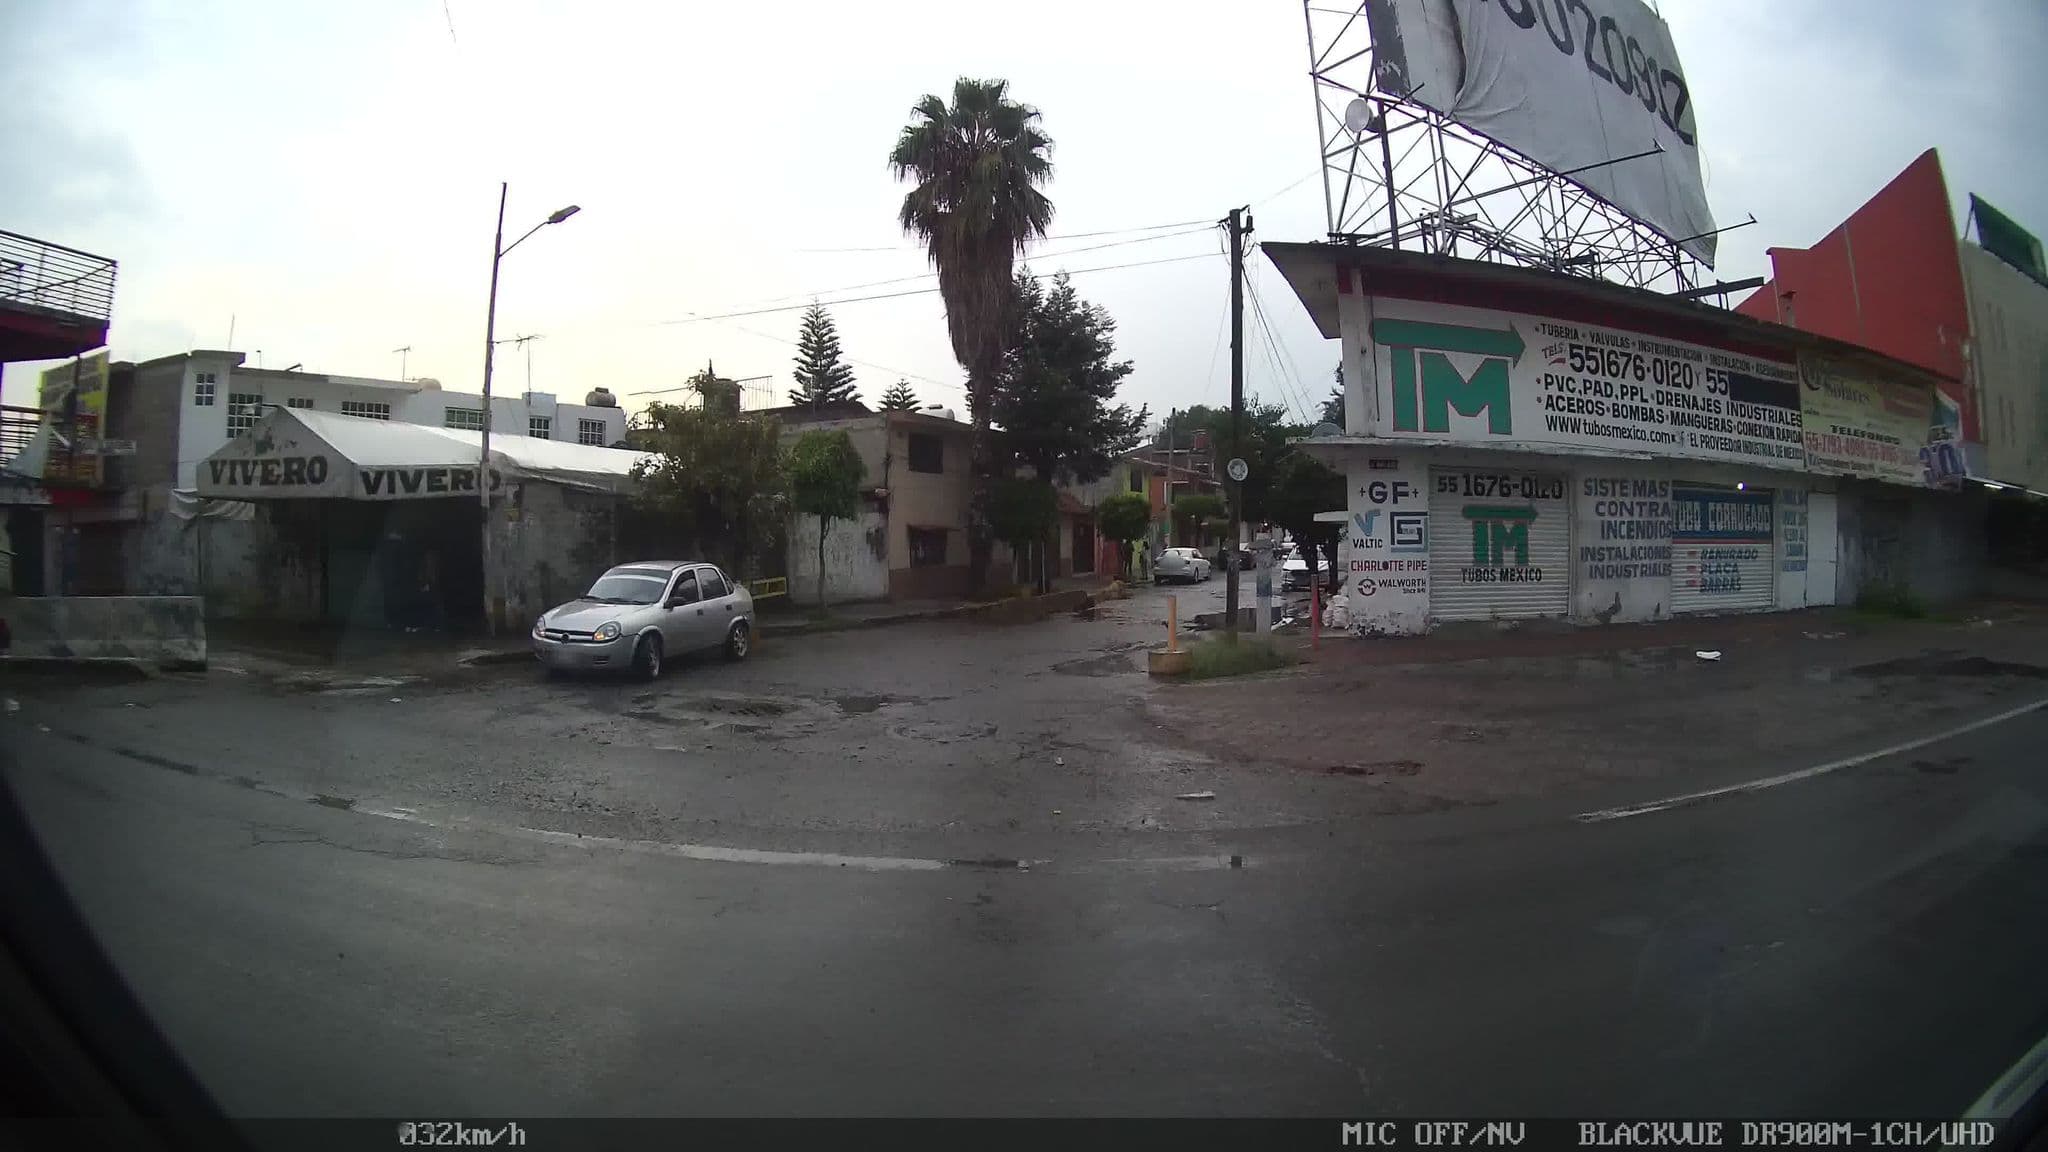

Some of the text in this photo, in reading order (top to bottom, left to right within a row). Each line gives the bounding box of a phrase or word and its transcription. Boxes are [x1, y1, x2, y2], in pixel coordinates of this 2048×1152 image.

[1540, 323, 1579, 341] TUBERIA
[1589, 331, 1631, 349] VALVULAS
[1705, 367, 1728, 396] 55
[1544, 394, 1605, 417] ACEROS
[1612, 402, 1665, 424] BOMBAS
[1670, 410, 1733, 434] MANGUERAS
[1656, 389, 1722, 415] DRENAJES
[1726, 400, 1802, 428] INDUSTRIALES
[1700, 434, 1742, 454] PROVEEDOR
[209, 456, 328, 486] VIVERO
[360, 468, 501, 495] VIVERO
[1437, 475, 1459, 494] 55
[1583, 479, 1669, 498] SISTEMAS
[1595, 500, 1672, 518] CONTRA
[1600, 520, 1672, 540] INCENDIOS
[1352, 538, 1383, 550] VALTIC
[1579, 546, 1672, 562] INSTALACIONES
[1351, 560, 1428, 572] CHARLOTTE PIPE
[1461, 567, 1543, 584] TUBOS MEXICO
[1588, 563, 1672, 580] INDUSTRIALES
[1378, 578, 1427, 588] WALWORTH
